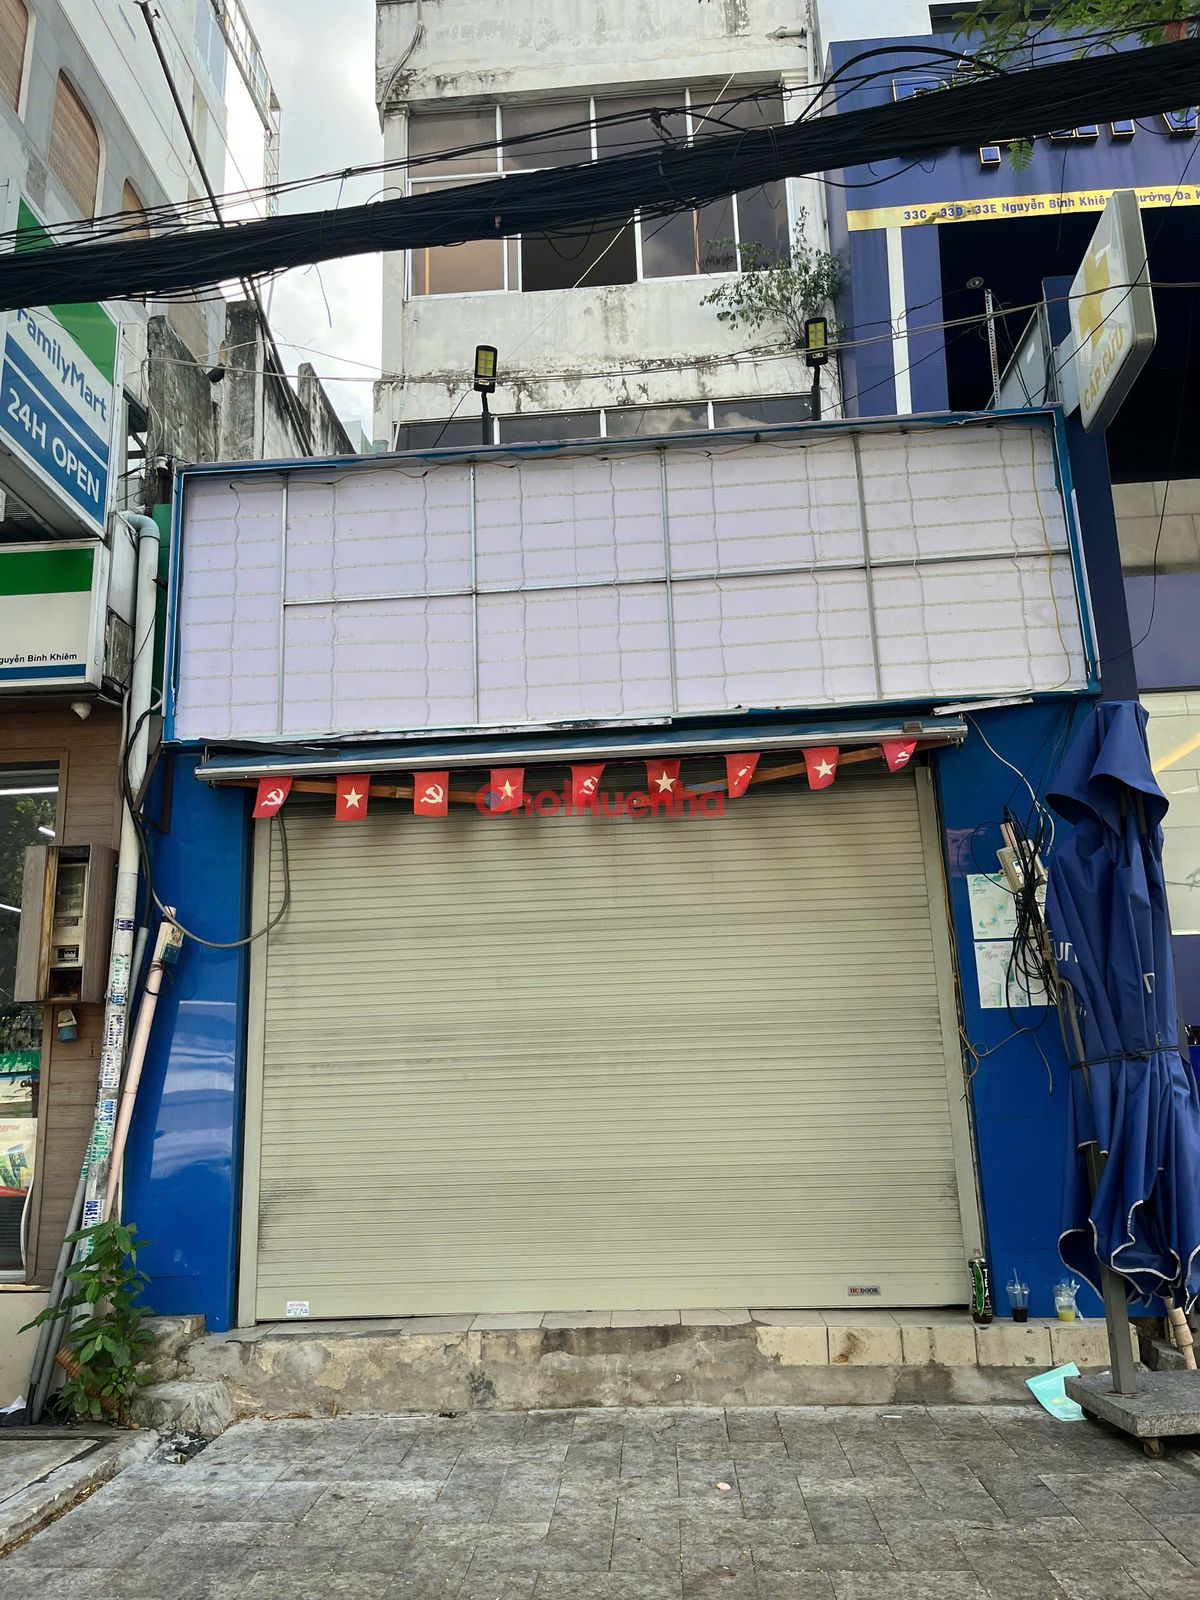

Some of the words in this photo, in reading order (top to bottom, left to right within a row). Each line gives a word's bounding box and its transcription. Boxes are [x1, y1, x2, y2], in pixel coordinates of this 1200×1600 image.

[904, 209, 927, 220] 33C
[974, 204, 997, 214] 33E
[1001, 198, 1045, 214] Nguyễn
[1079, 195, 1106, 206] Khiê
[1136, 191, 1171, 203] ường
[7, 387, 47, 450] 24H
[52, 436, 100, 504] OPEN
[50, 652, 77, 661] Khiêm
